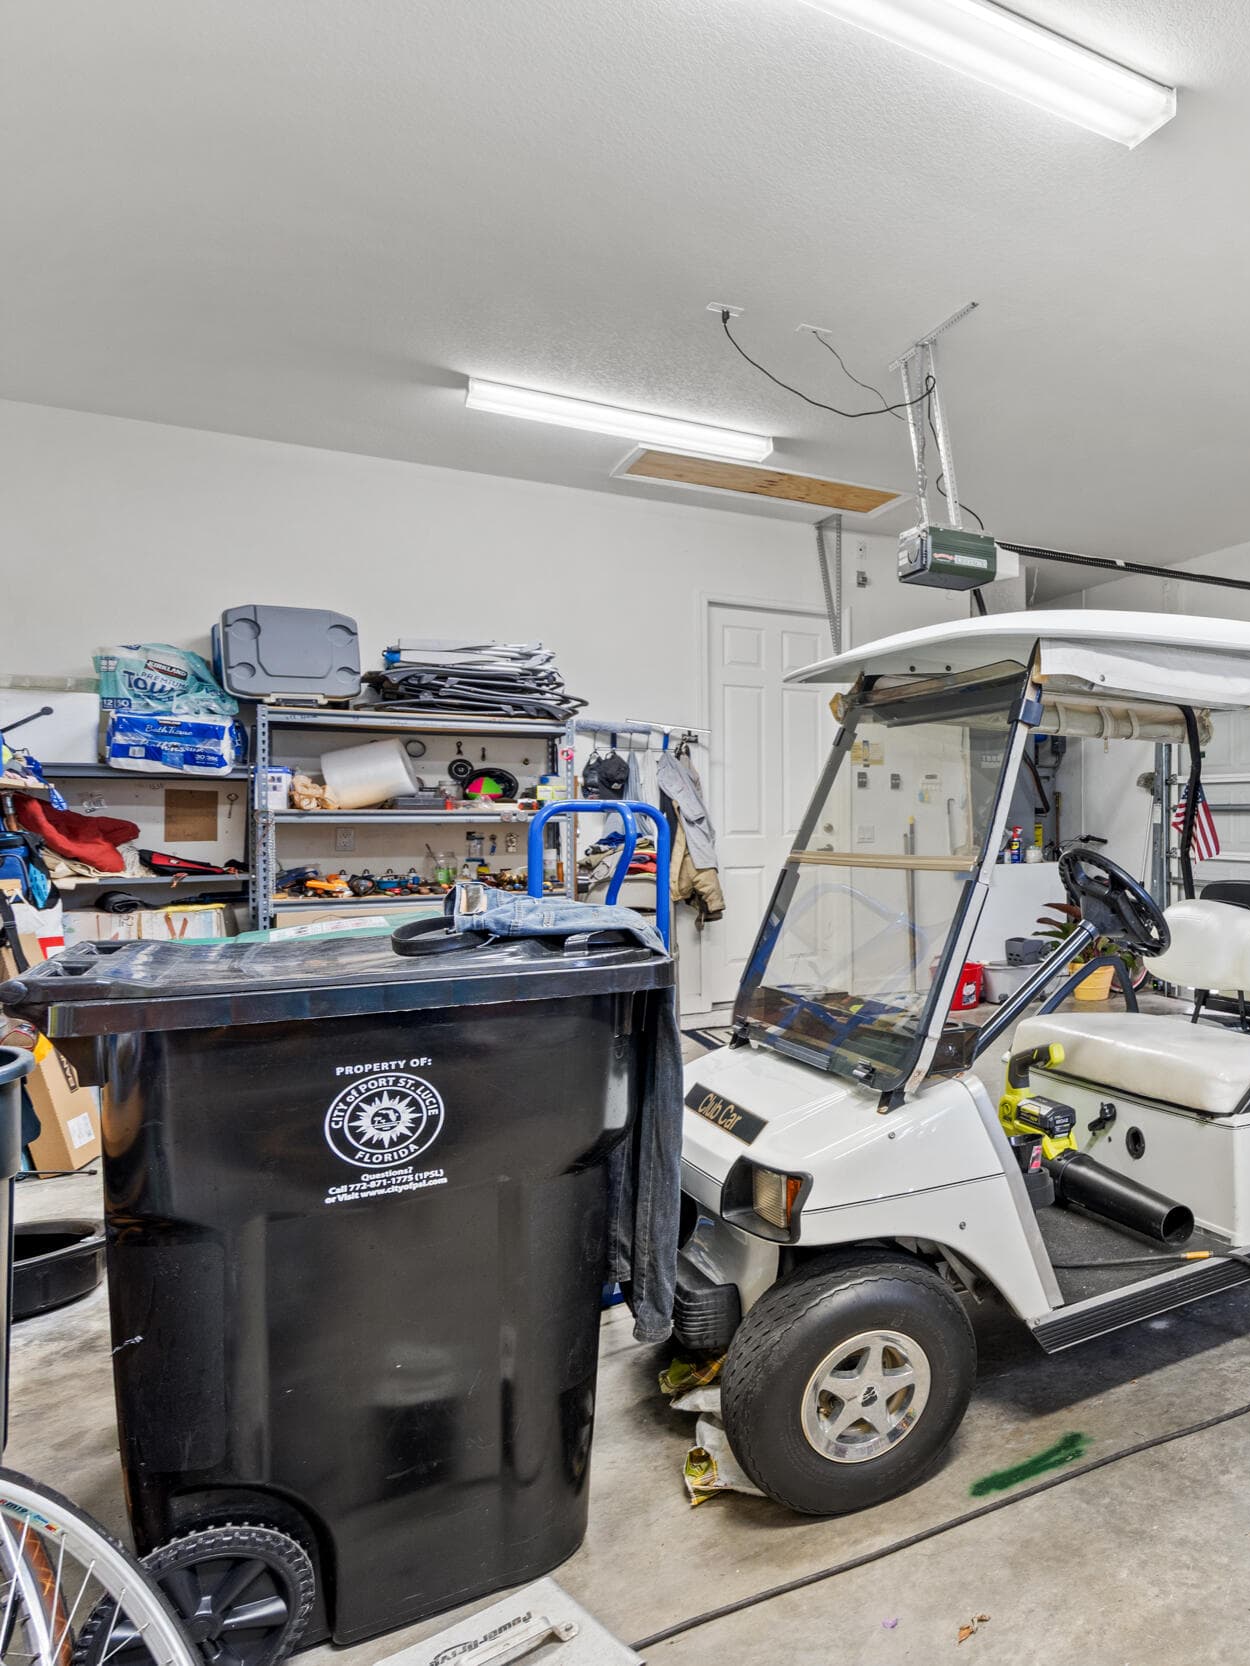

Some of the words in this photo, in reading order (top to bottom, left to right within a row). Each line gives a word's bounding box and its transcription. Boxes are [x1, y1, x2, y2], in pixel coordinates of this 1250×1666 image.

[147, 660, 187, 676] KIRKLAND
[335, 1060, 406, 1076] PROPERTY
[409, 1057, 432, 1068] OF:
[330, 1102, 348, 1129] CITY
[346, 1090, 359, 1103] of
[360, 1077, 397, 1093] PORT
[397, 1078, 416, 1091] ST.
[416, 1085, 439, 1116] LUCIE
[698, 1093, 723, 1120] Club
[717, 1104, 742, 1131] Car
[354, 1143, 420, 1163] FLORIDA
[328, 1185, 348, 1195] Call
[348, 1174, 414, 1192] 772-871-1775
[414, 1169, 444, 1181] (1PSL)
[361, 1166, 414, 1181] Questions?
[324, 1196, 337, 1204] or
[337, 1192, 360, 1202] Visit
[360, 1177, 448, 1198] www.cityofpsl.com
